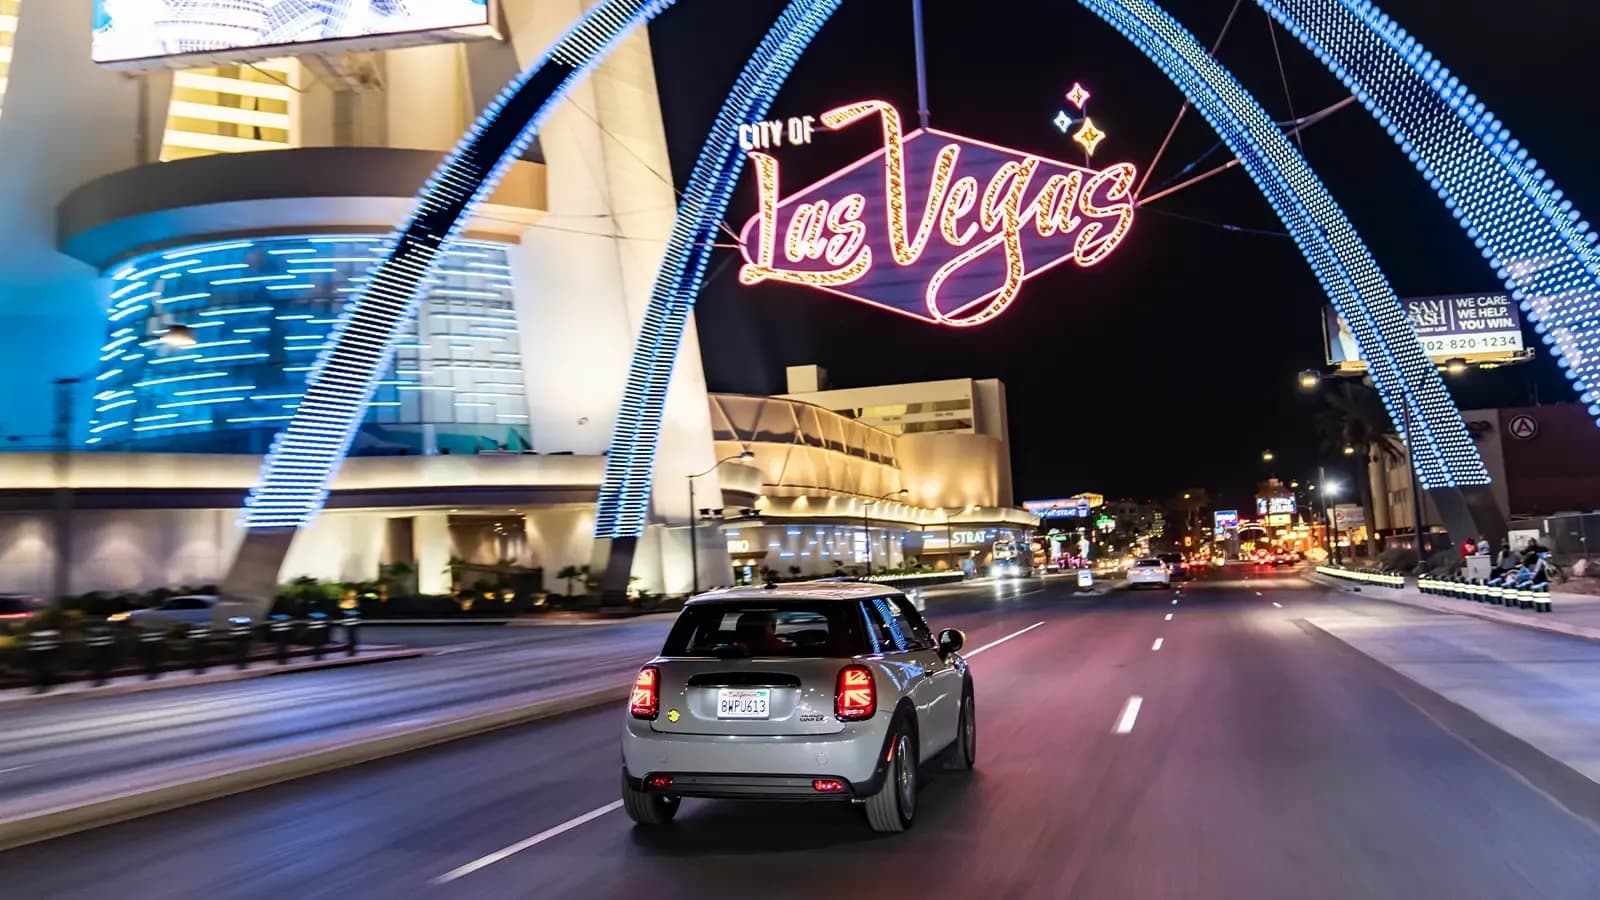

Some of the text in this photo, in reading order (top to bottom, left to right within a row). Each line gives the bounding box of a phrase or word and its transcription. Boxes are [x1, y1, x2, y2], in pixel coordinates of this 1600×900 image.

[738, 115, 816, 150] CITY OF
[739, 99, 1137, 327] Las Vegas
[1408, 299, 1445, 315] SAM
[1456, 296, 1511, 309] WE CARE.
[1457, 306, 1509, 319] WE HELP.
[1458, 317, 1516, 331] YOU WIN.
[951, 530, 987, 545] STRAT
[721, 699, 767, 713] 8WPU613
